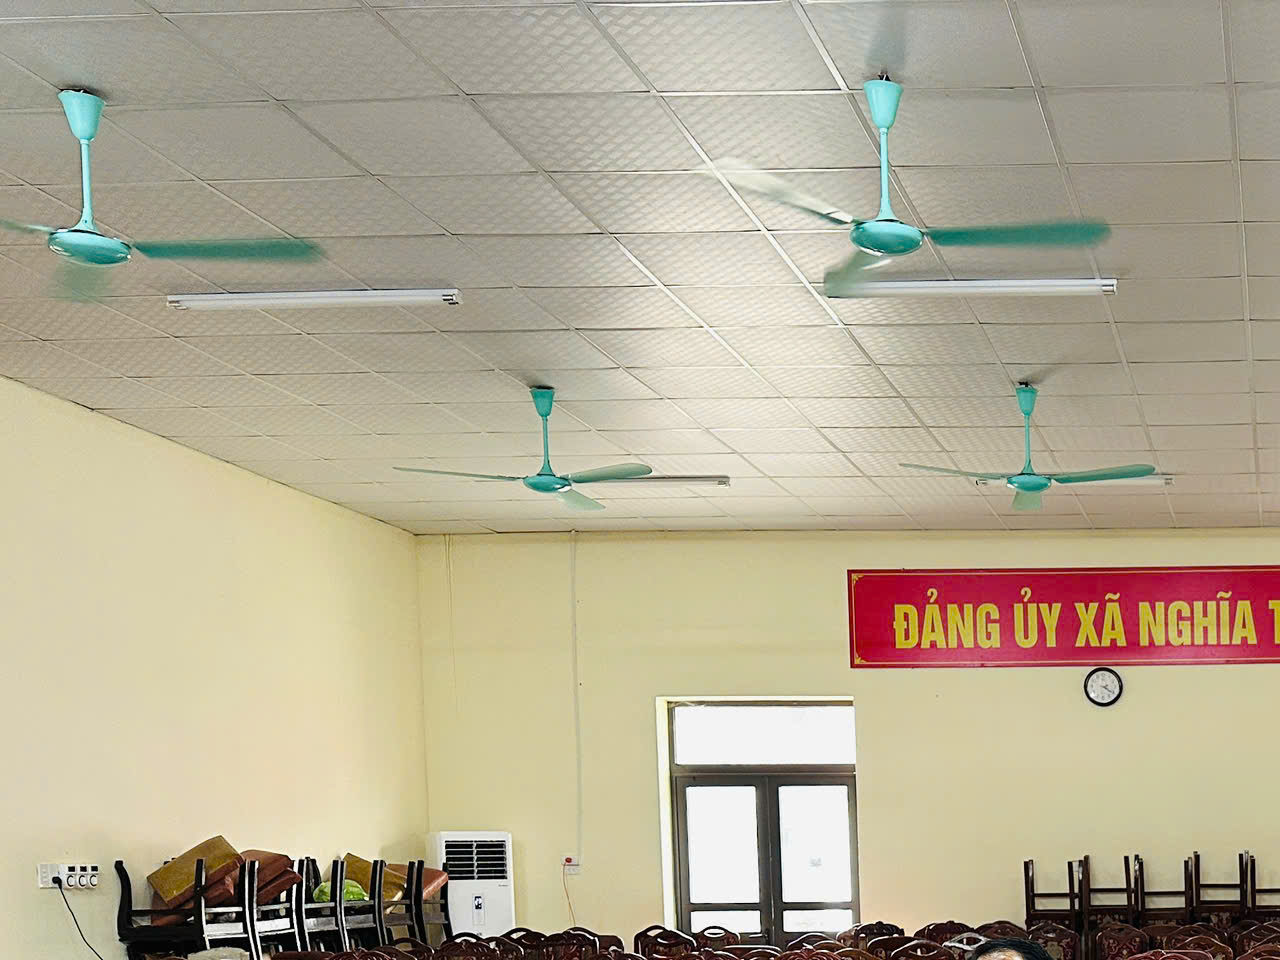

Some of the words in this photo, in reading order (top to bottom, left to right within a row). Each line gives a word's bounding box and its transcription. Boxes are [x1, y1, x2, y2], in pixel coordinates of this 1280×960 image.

[893, 588, 1000, 649] ĐẢNG
[1014, 587, 1062, 648] ỦY
[1075, 592, 1127, 647] XÃ
[1139, 590, 1258, 647] NGHĨA
